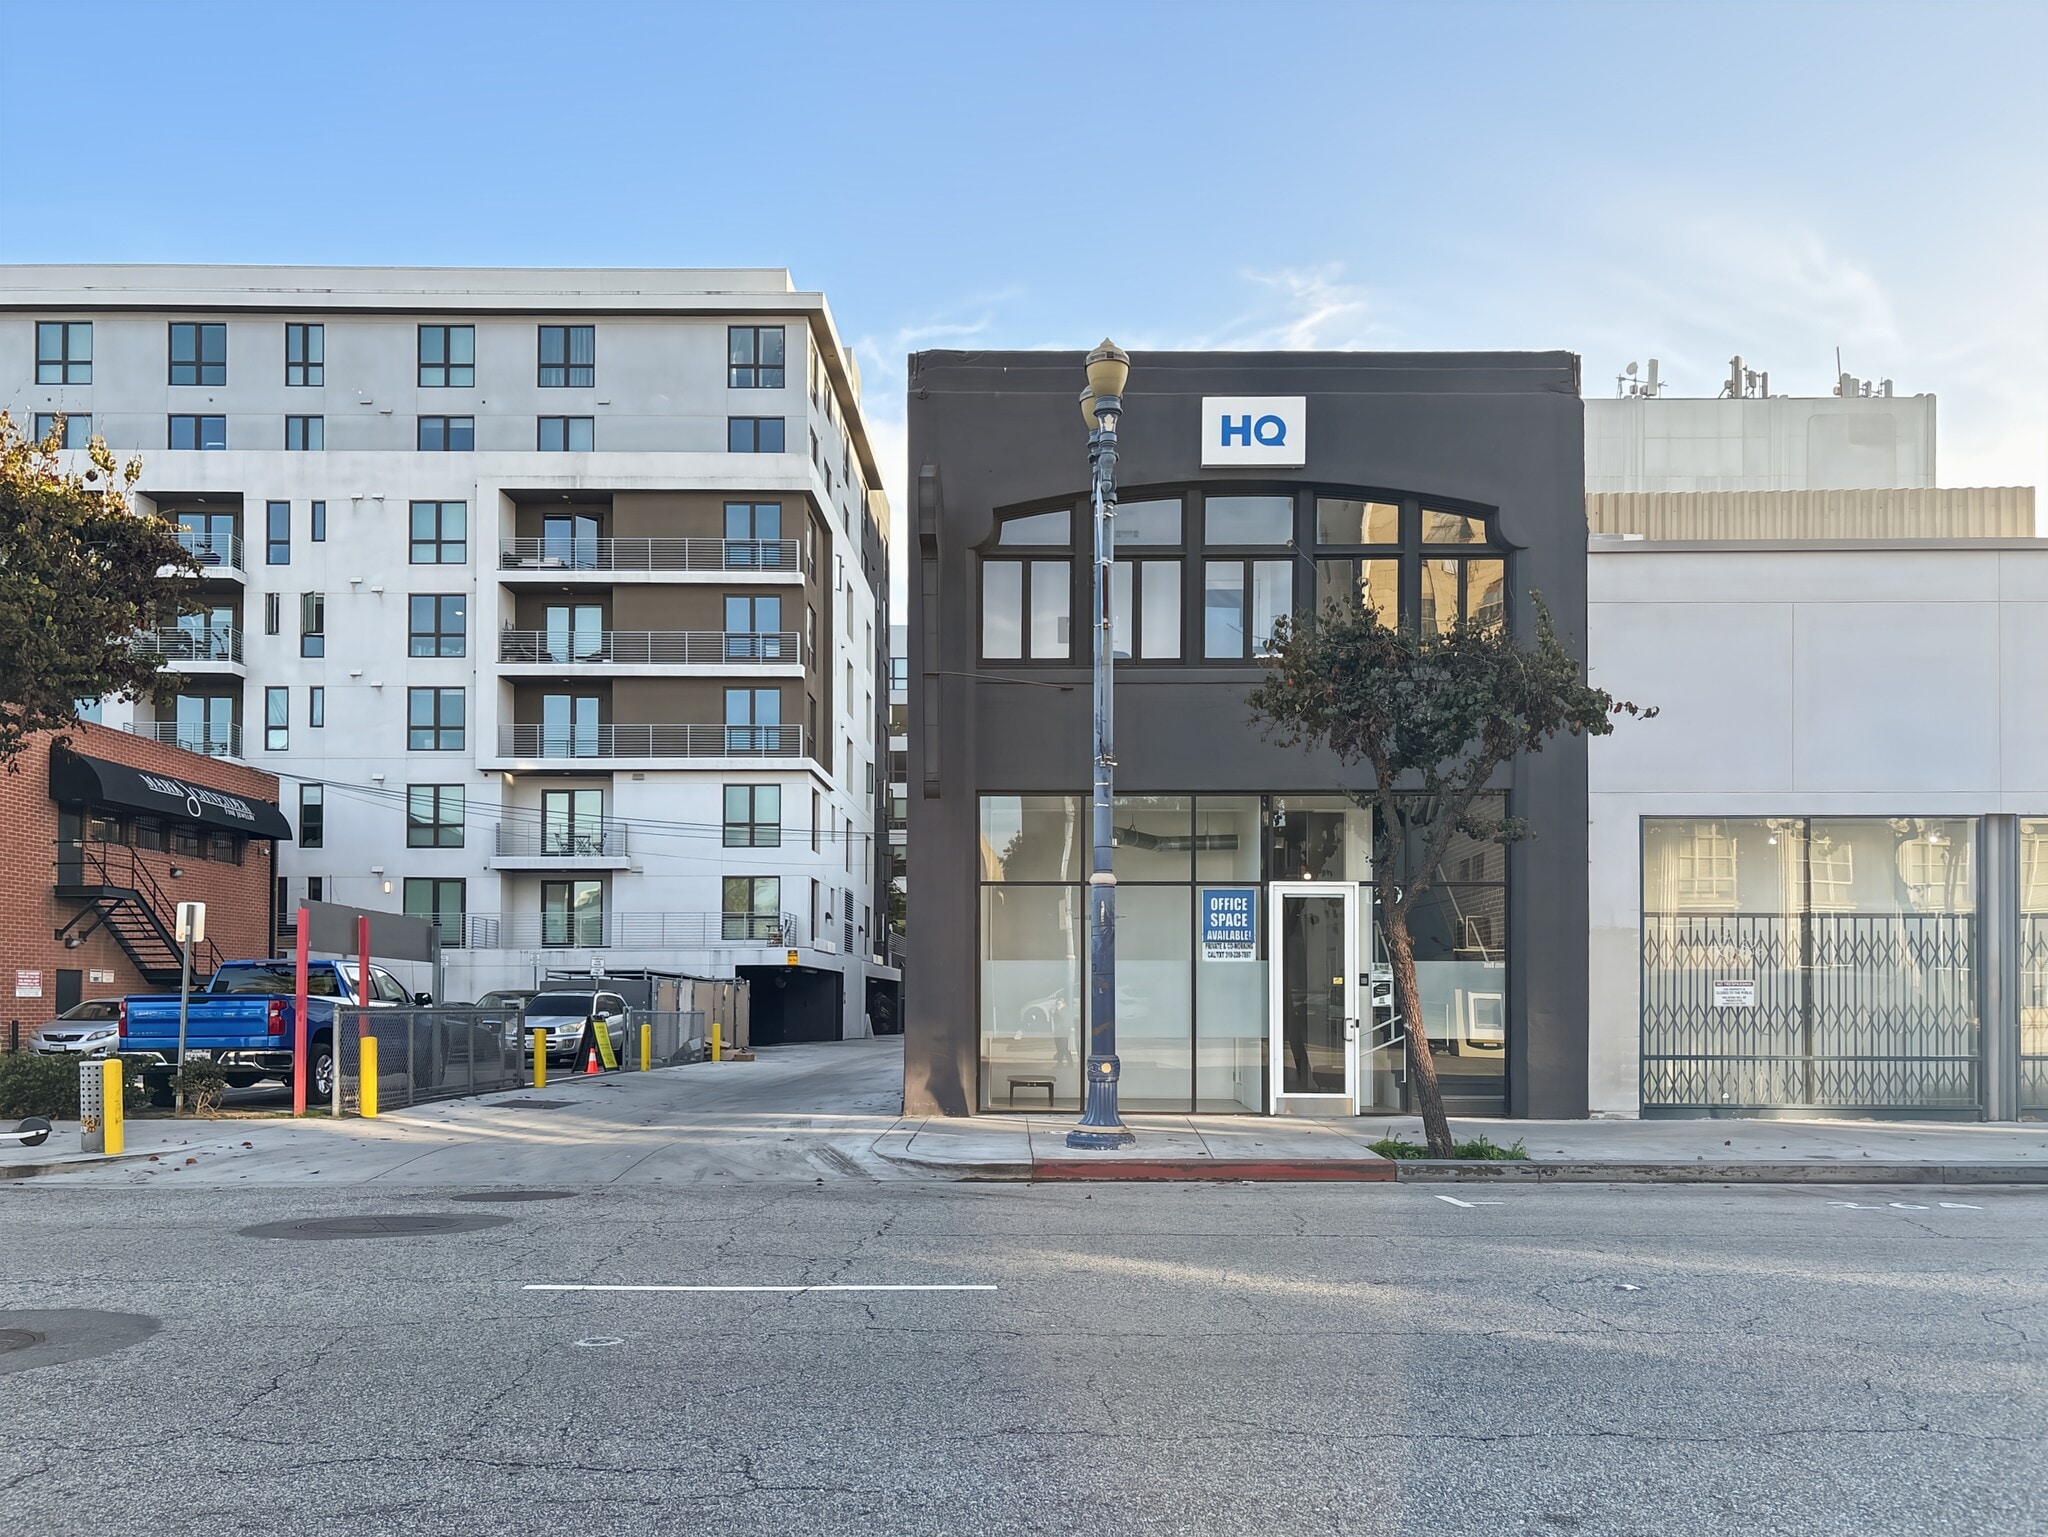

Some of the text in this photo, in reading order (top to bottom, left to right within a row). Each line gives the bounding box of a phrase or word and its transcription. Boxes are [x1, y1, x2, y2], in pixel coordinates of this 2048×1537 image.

[1221, 415, 1287, 447] HQ
[138, 774, 252, 817] MARK SCHNEIDER
[1210, 897, 1248, 911] OFFICE
[1210, 913, 1248, 927] SPACE
[1207, 930, 1251, 941] AVAILABLE!
